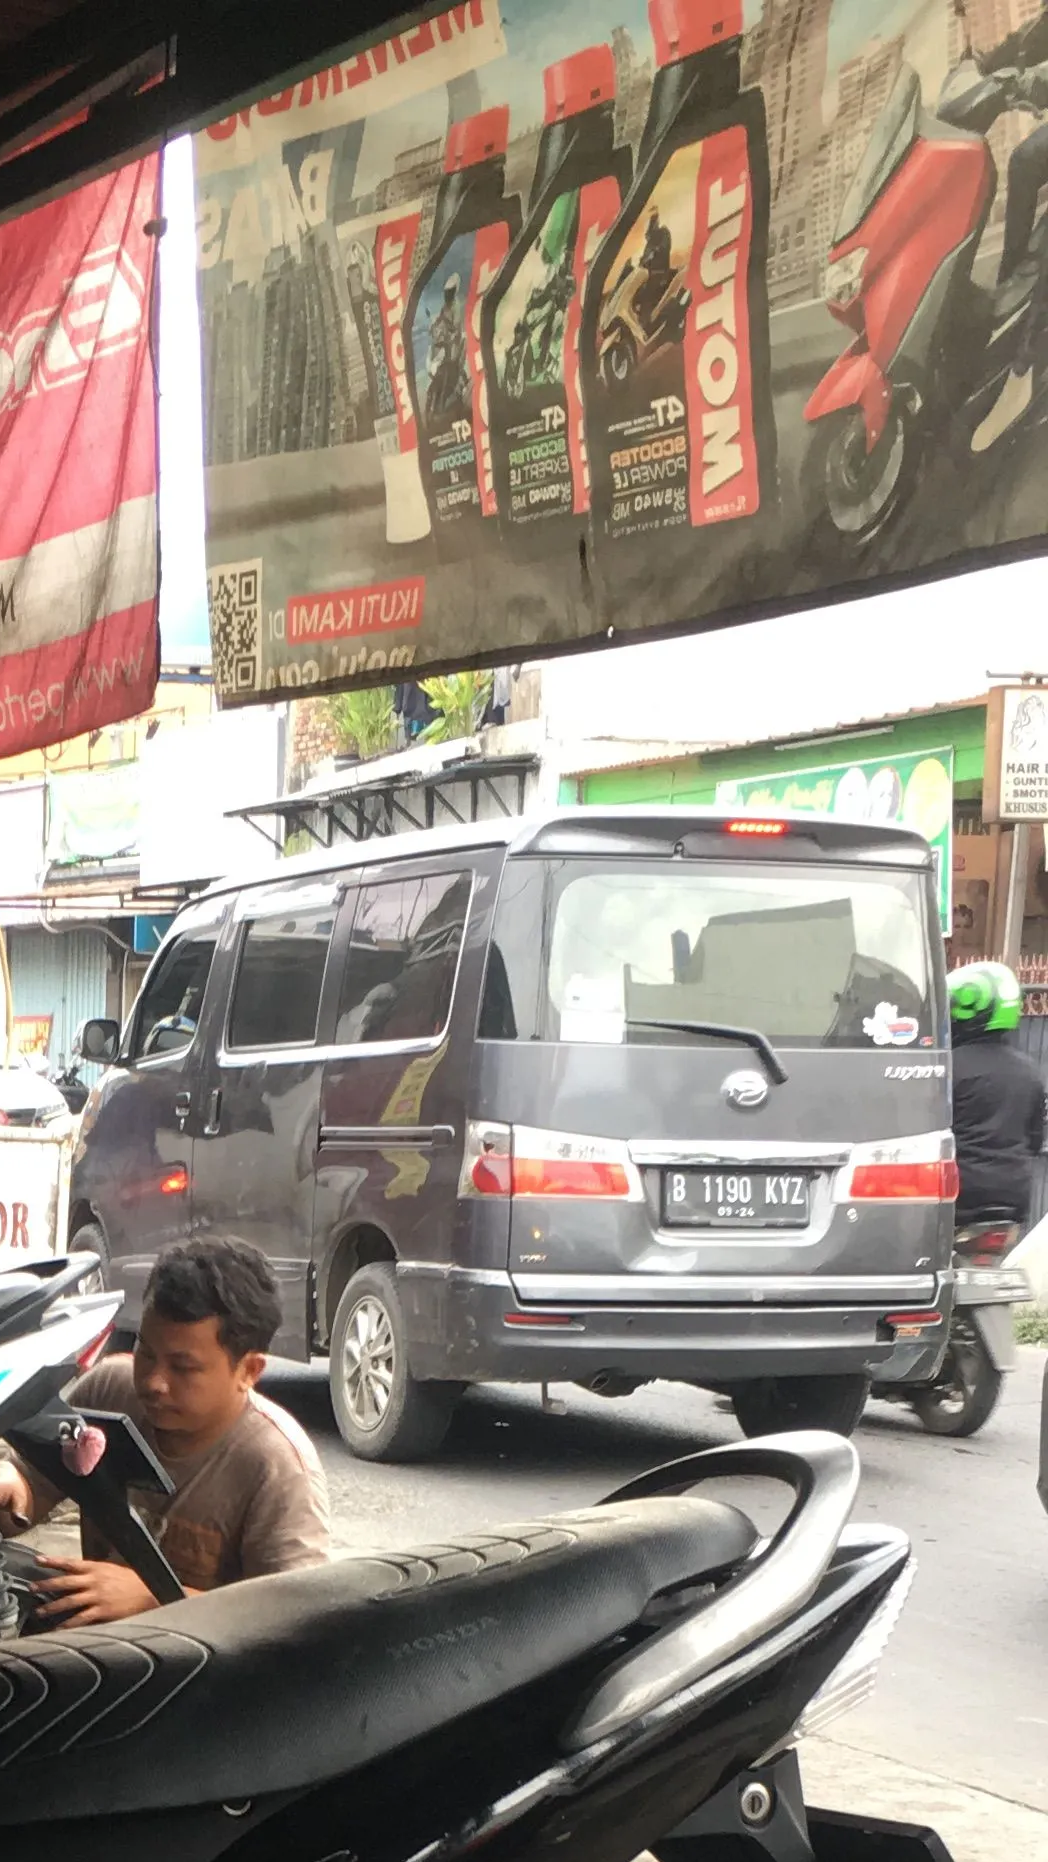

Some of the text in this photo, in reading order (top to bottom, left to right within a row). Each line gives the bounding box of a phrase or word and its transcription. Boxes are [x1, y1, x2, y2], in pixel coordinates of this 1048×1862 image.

[1006, 762, 1039, 774] HAIR
[1005, 801, 1048, 813] KHUSUS
[672, 1174, 805, 1205] B 1190 KYZ
